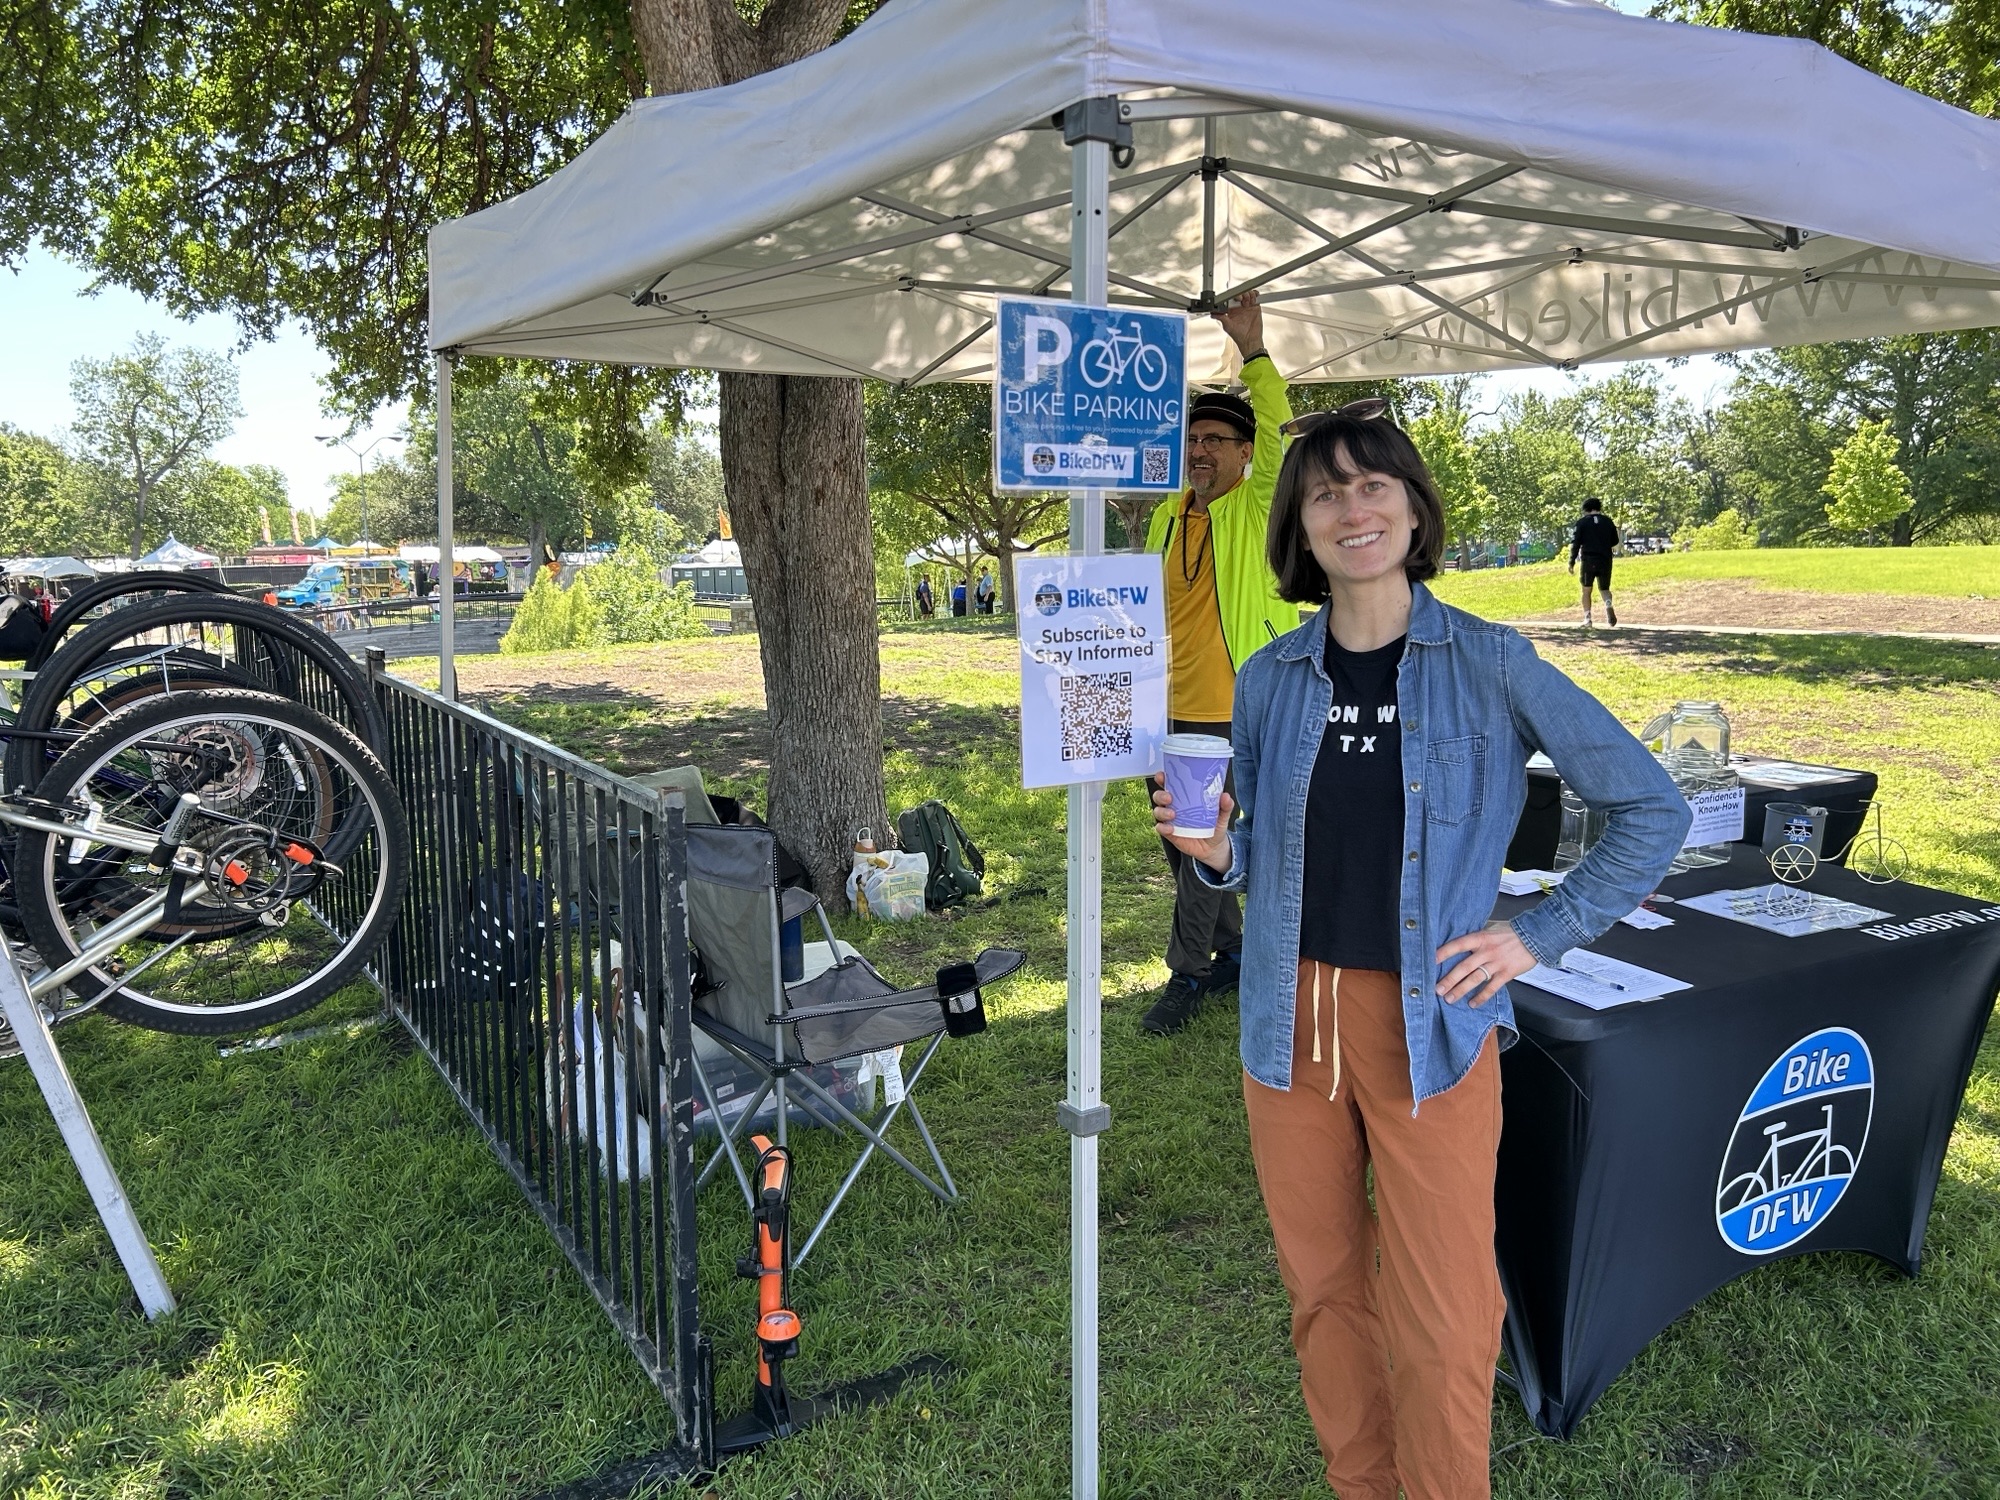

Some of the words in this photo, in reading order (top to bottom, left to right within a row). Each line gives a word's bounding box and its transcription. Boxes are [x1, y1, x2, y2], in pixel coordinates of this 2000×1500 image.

[1024, 314, 1073, 382] P
[1005, 389, 1066, 416] BIKE
[1074, 393, 1180, 422] PARKING
[1059, 451, 1127, 471] BikeDFW
[1067, 586, 1149, 608] BikeDFW
[1042, 624, 1125, 644] Subscribe
[1129, 625, 1146, 639] to
[1035, 647, 1073, 666] Stay
[1077, 641, 1154, 661] Informed
[1693, 791, 1737, 805] Confidence
[1698, 802, 1739, 815] Know-How
[1860, 906, 2000, 941] BikeDFW.o
[1783, 1048, 1851, 1095] Bike
[1747, 1187, 1823, 1242] DFW
